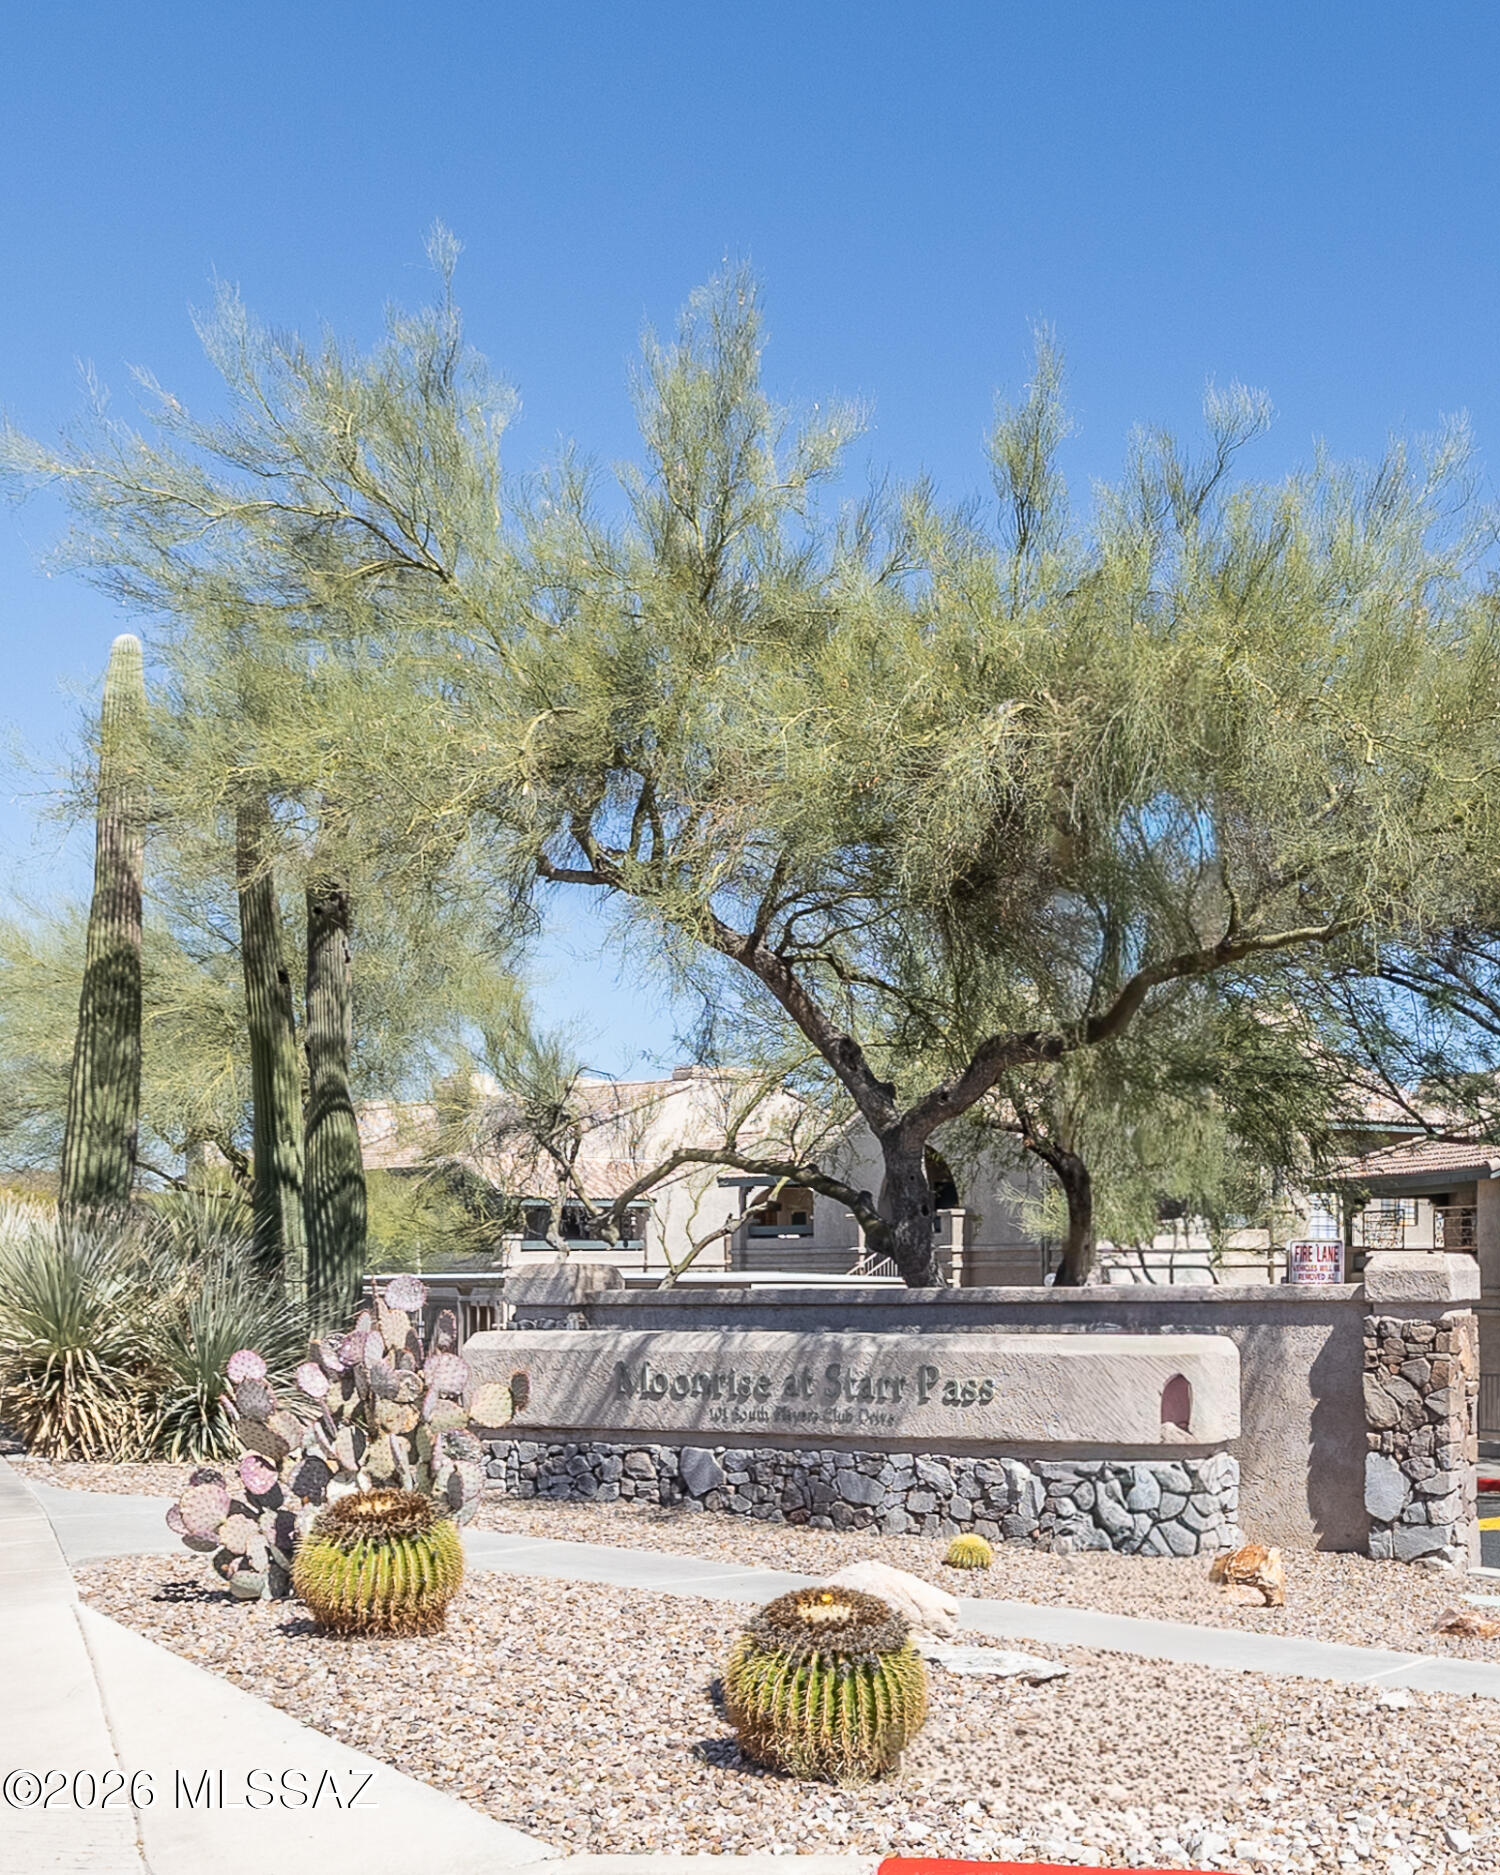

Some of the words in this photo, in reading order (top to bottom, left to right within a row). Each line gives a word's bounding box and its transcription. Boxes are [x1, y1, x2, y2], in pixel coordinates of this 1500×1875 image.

[1294, 1245, 1313, 1263] FIRE
[1316, 1245, 1340, 1263] LANE
[1293, 1264, 1318, 1272] VEHICLES
[1298, 1273, 1326, 1281] REMOVED
[613, 1360, 772, 1403] Moonrise
[782, 1365, 815, 1402] at
[823, 1363, 906, 1405] Starr
[917, 1364, 997, 1407] Pass
[732, 1406, 769, 1424] South
[822, 1407, 853, 1425] Club
